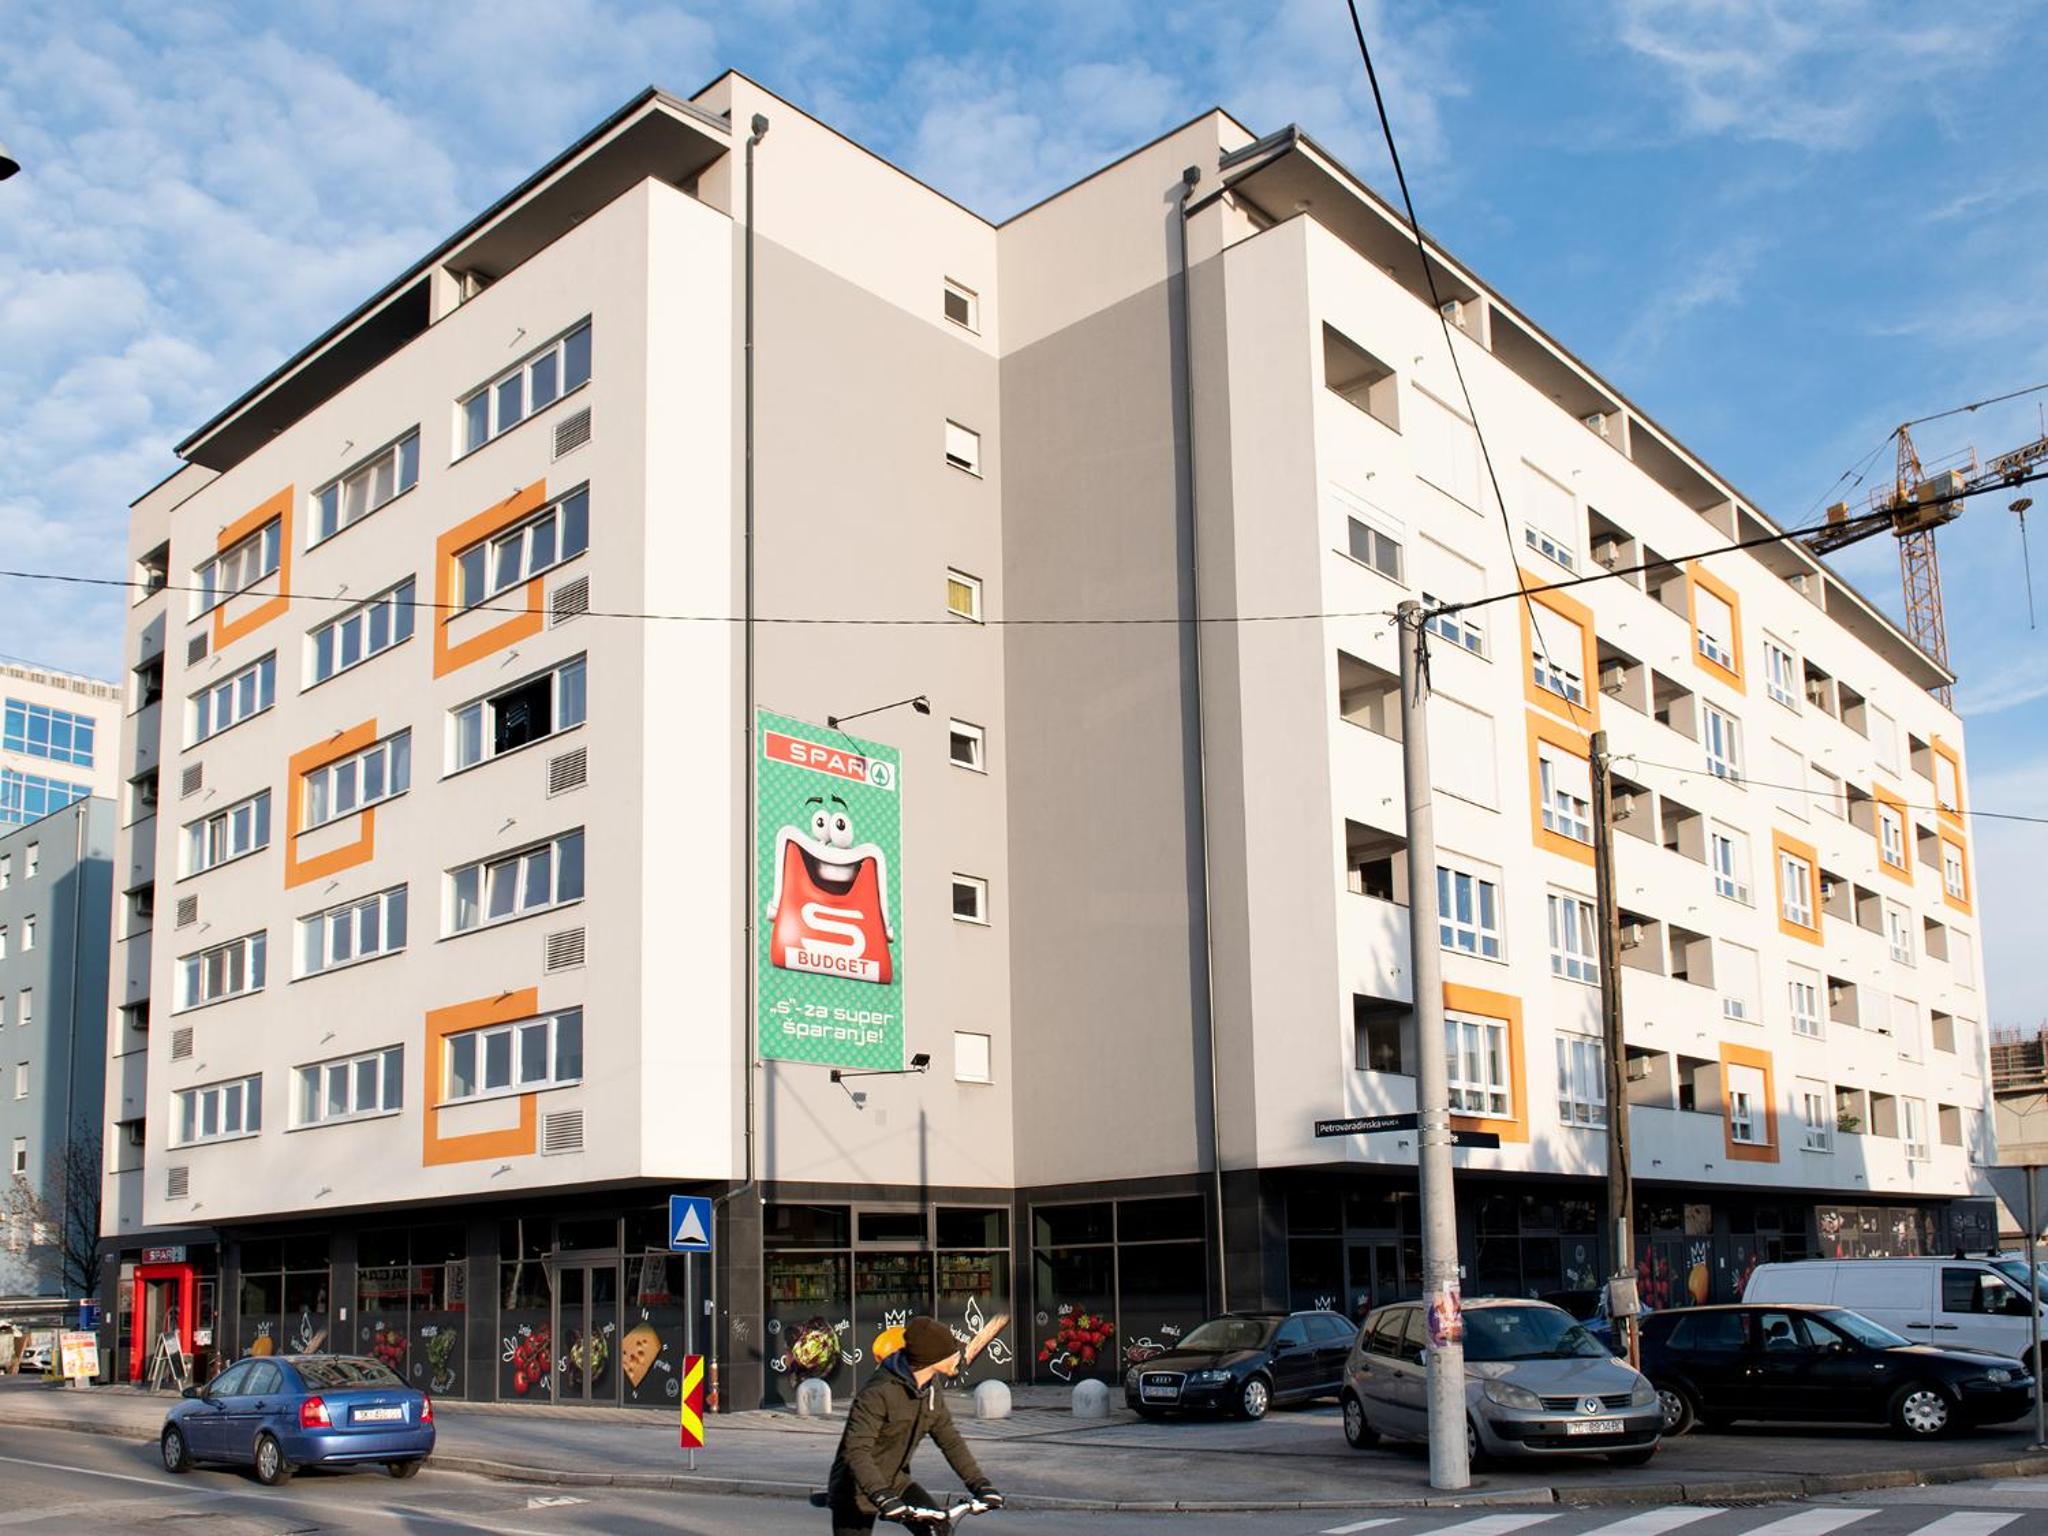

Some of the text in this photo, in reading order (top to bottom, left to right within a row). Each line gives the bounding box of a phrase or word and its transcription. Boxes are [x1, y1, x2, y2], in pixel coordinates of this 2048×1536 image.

[790, 742, 865, 777] SPAR
[798, 952, 869, 975] BUDGET
[833, 1007, 894, 1026] super
[783, 1017, 884, 1046] šparanje!
[1320, 1119, 1381, 1133] Petrovaradinska
